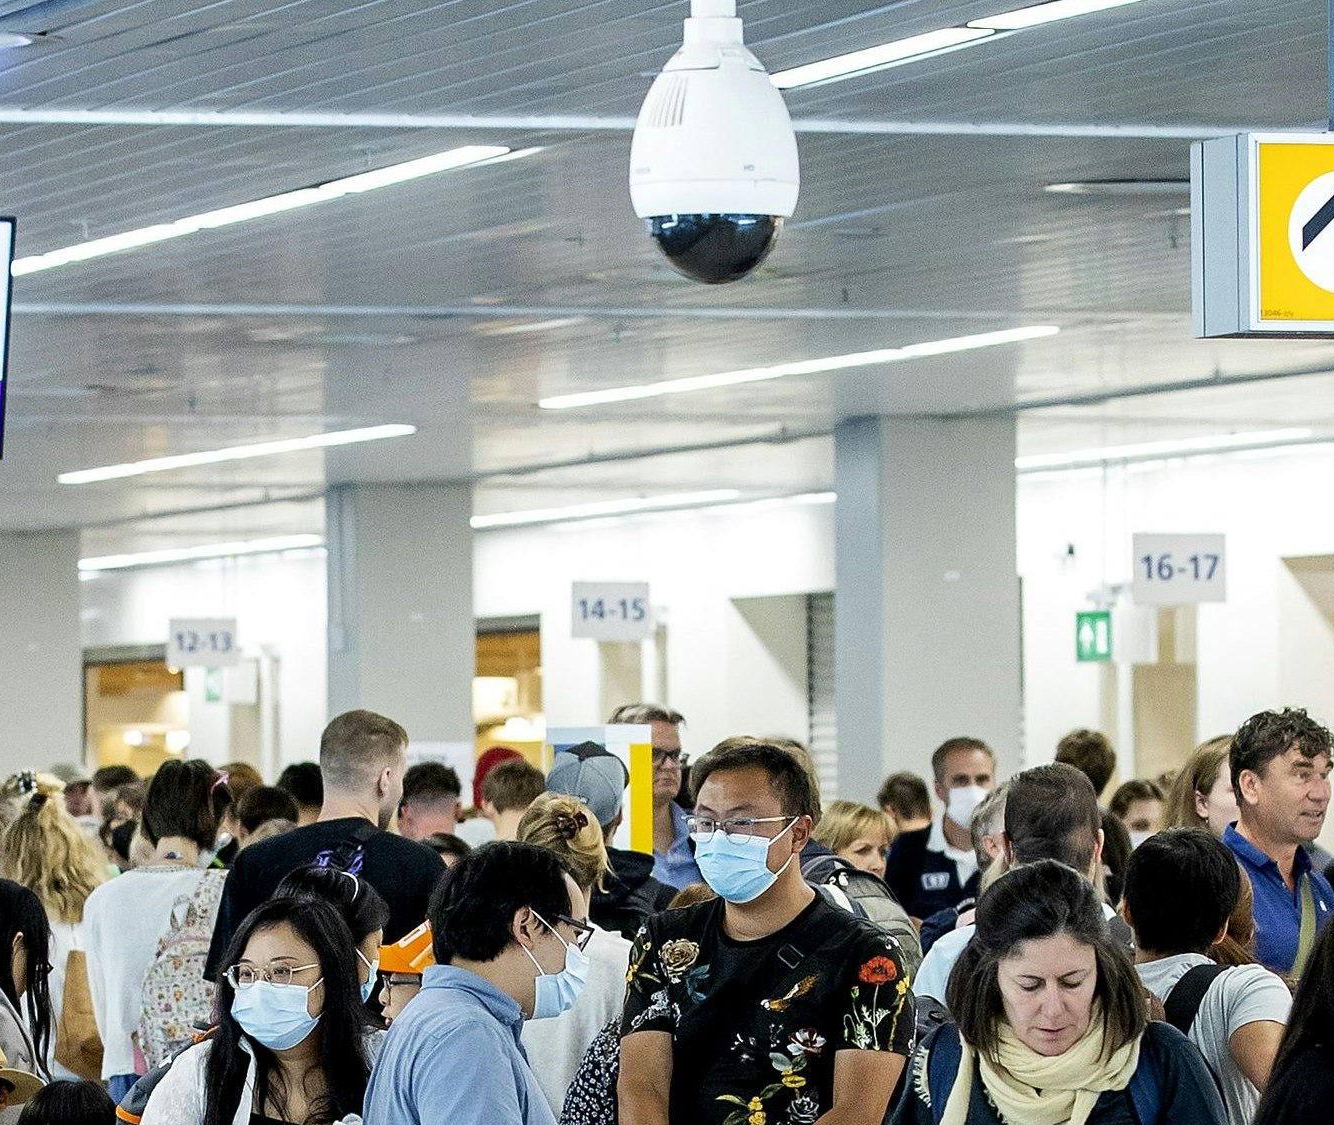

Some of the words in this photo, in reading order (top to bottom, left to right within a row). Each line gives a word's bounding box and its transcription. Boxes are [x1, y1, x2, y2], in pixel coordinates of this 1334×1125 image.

[1141, 552, 1219, 582] 16-17
[577, 597, 646, 622] 14-15
[176, 631, 233, 652] 12-13
